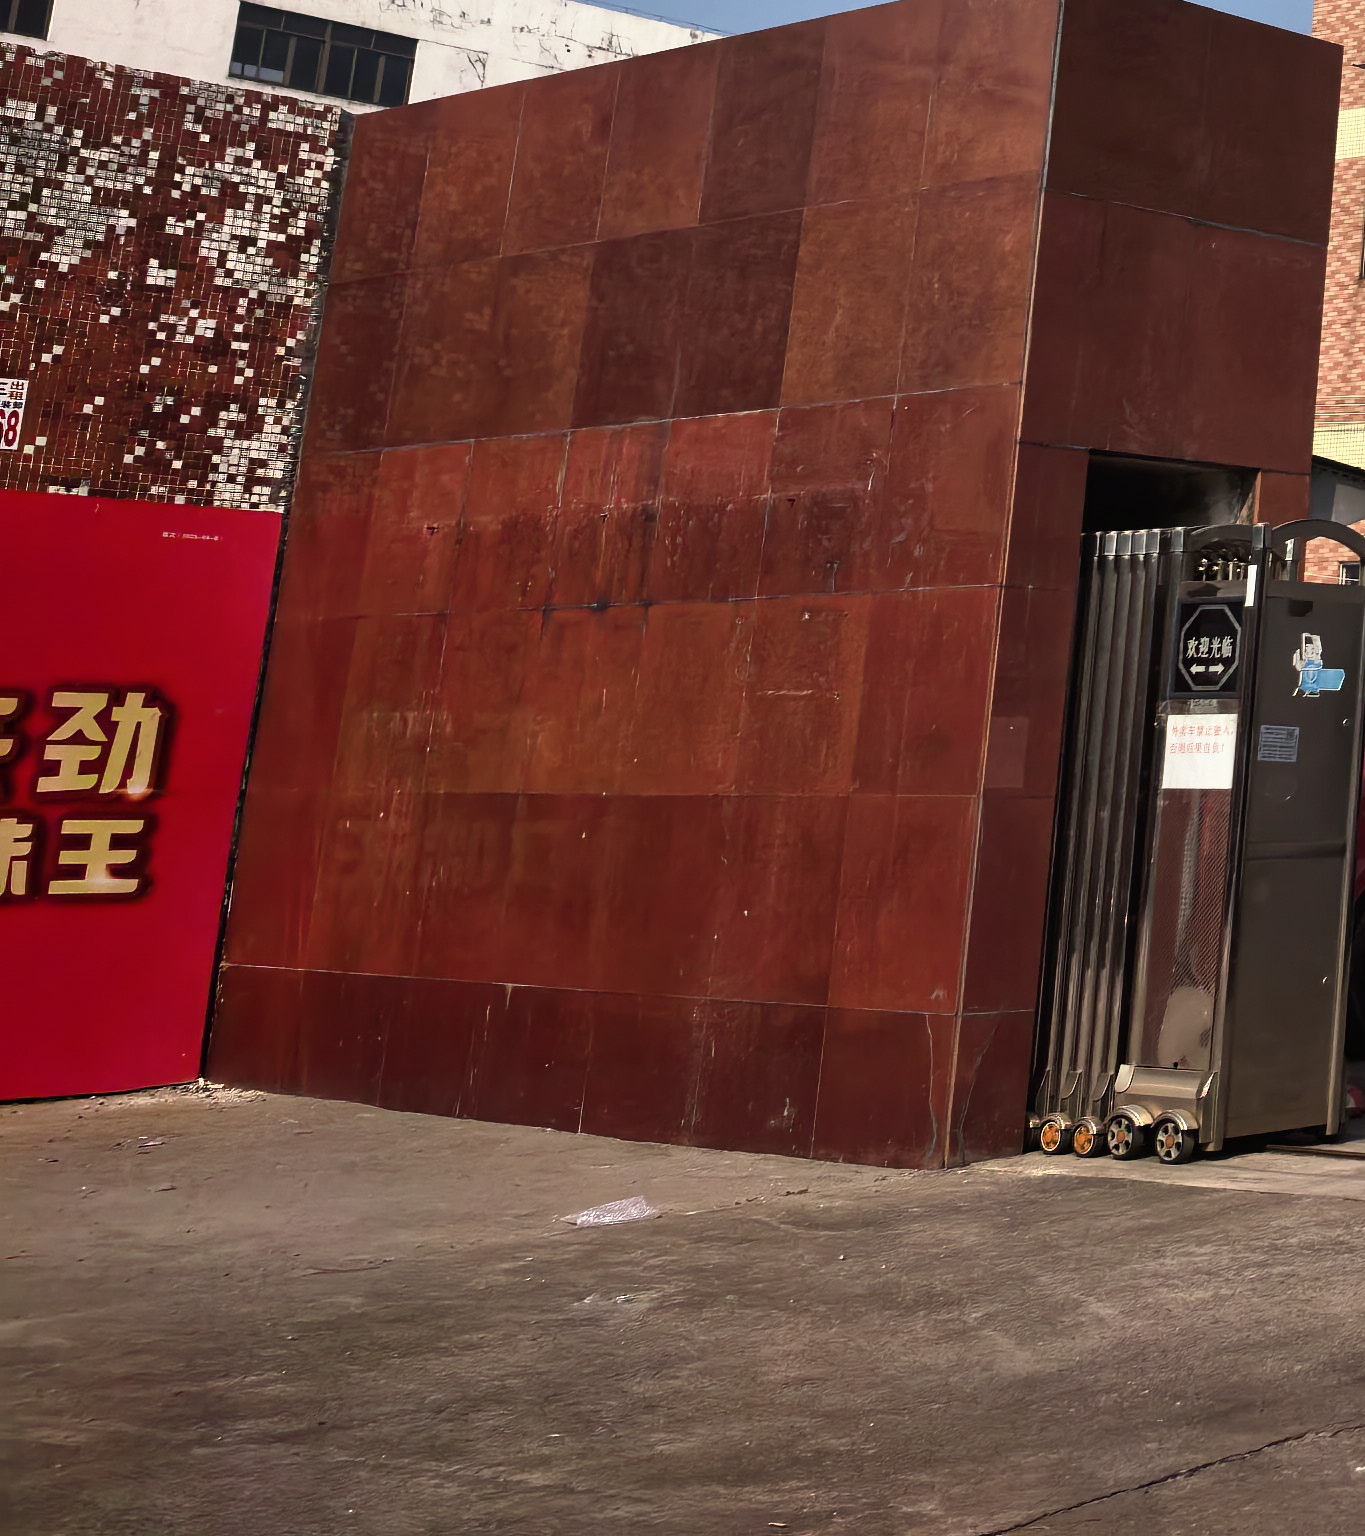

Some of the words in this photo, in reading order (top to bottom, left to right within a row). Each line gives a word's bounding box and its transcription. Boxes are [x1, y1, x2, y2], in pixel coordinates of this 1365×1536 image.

[1185, 635, 1233, 659] 欢迎光临
[0, 691, 162, 794] 劲
